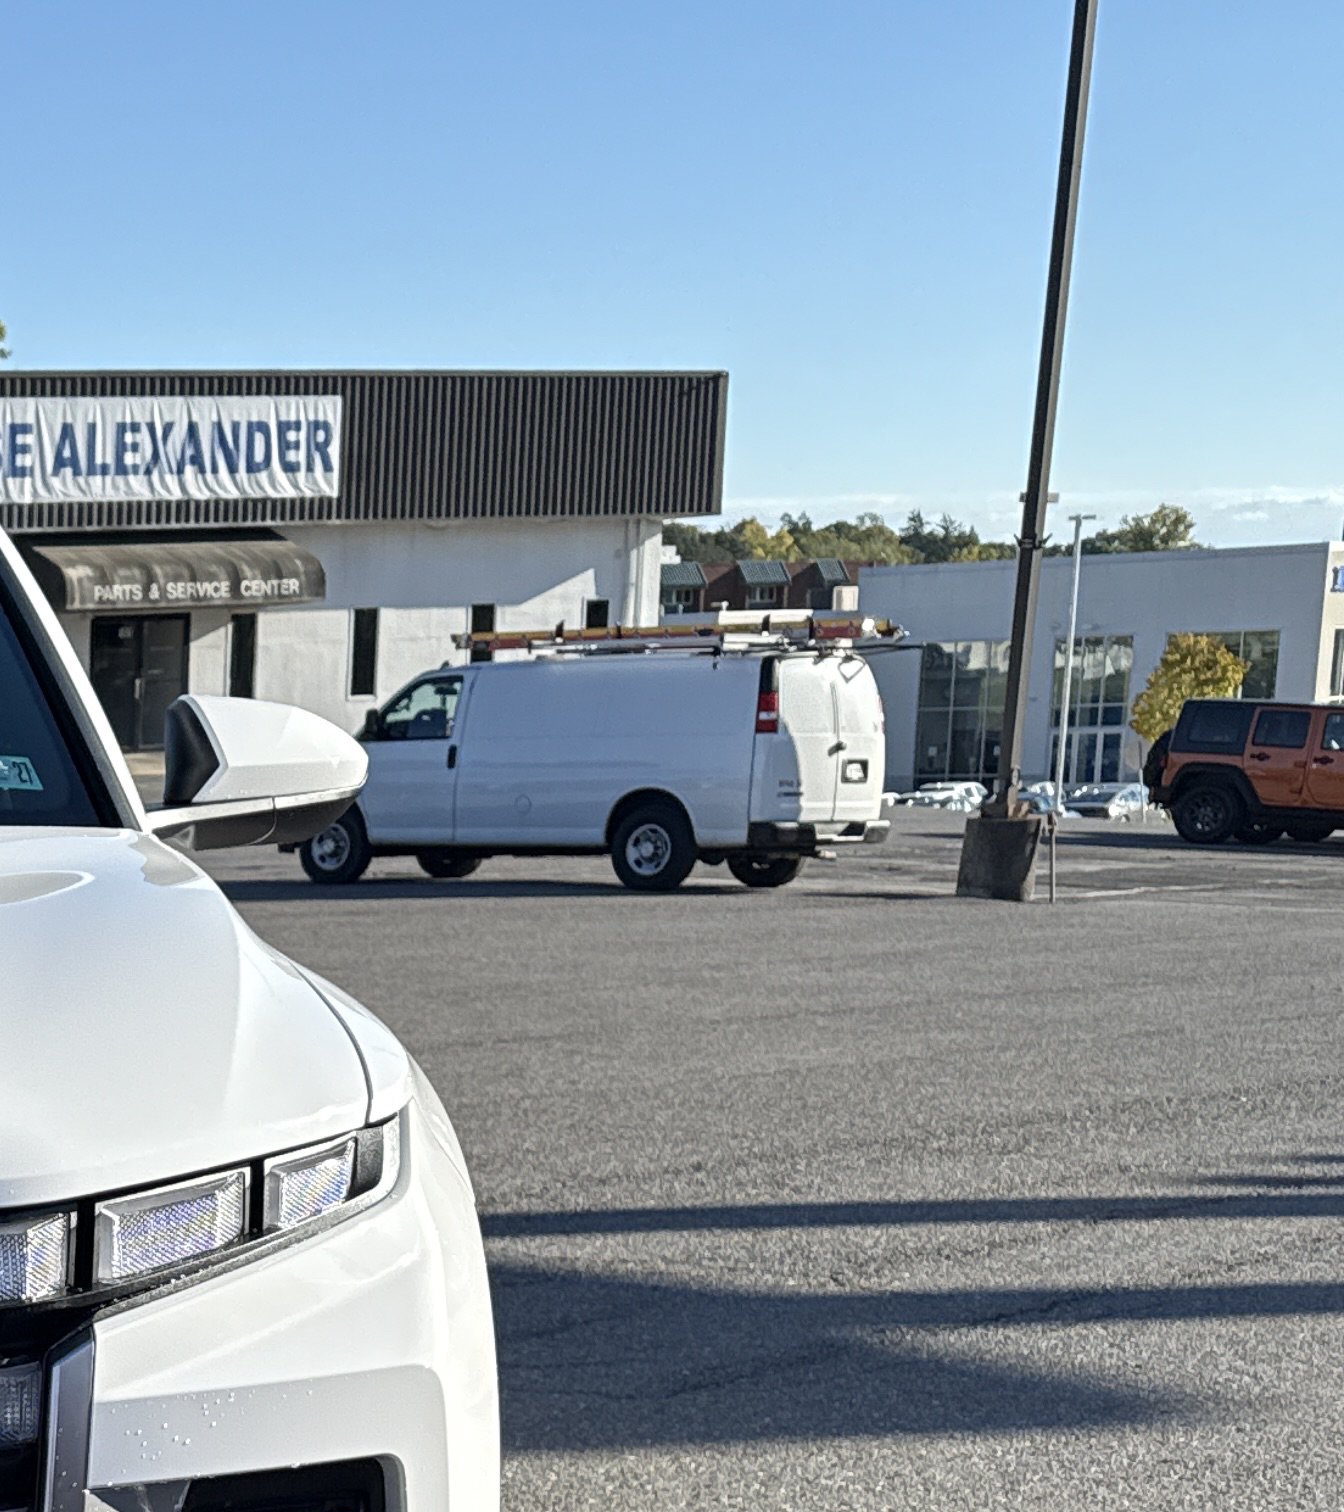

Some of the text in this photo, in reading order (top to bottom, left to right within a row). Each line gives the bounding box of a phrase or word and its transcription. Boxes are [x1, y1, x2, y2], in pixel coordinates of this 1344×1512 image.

[52, 419, 335, 479] ALEXANDER
[93, 578, 300, 601] PARTS & SERVICE CENTER
[12, 761, 34, 785] 27
